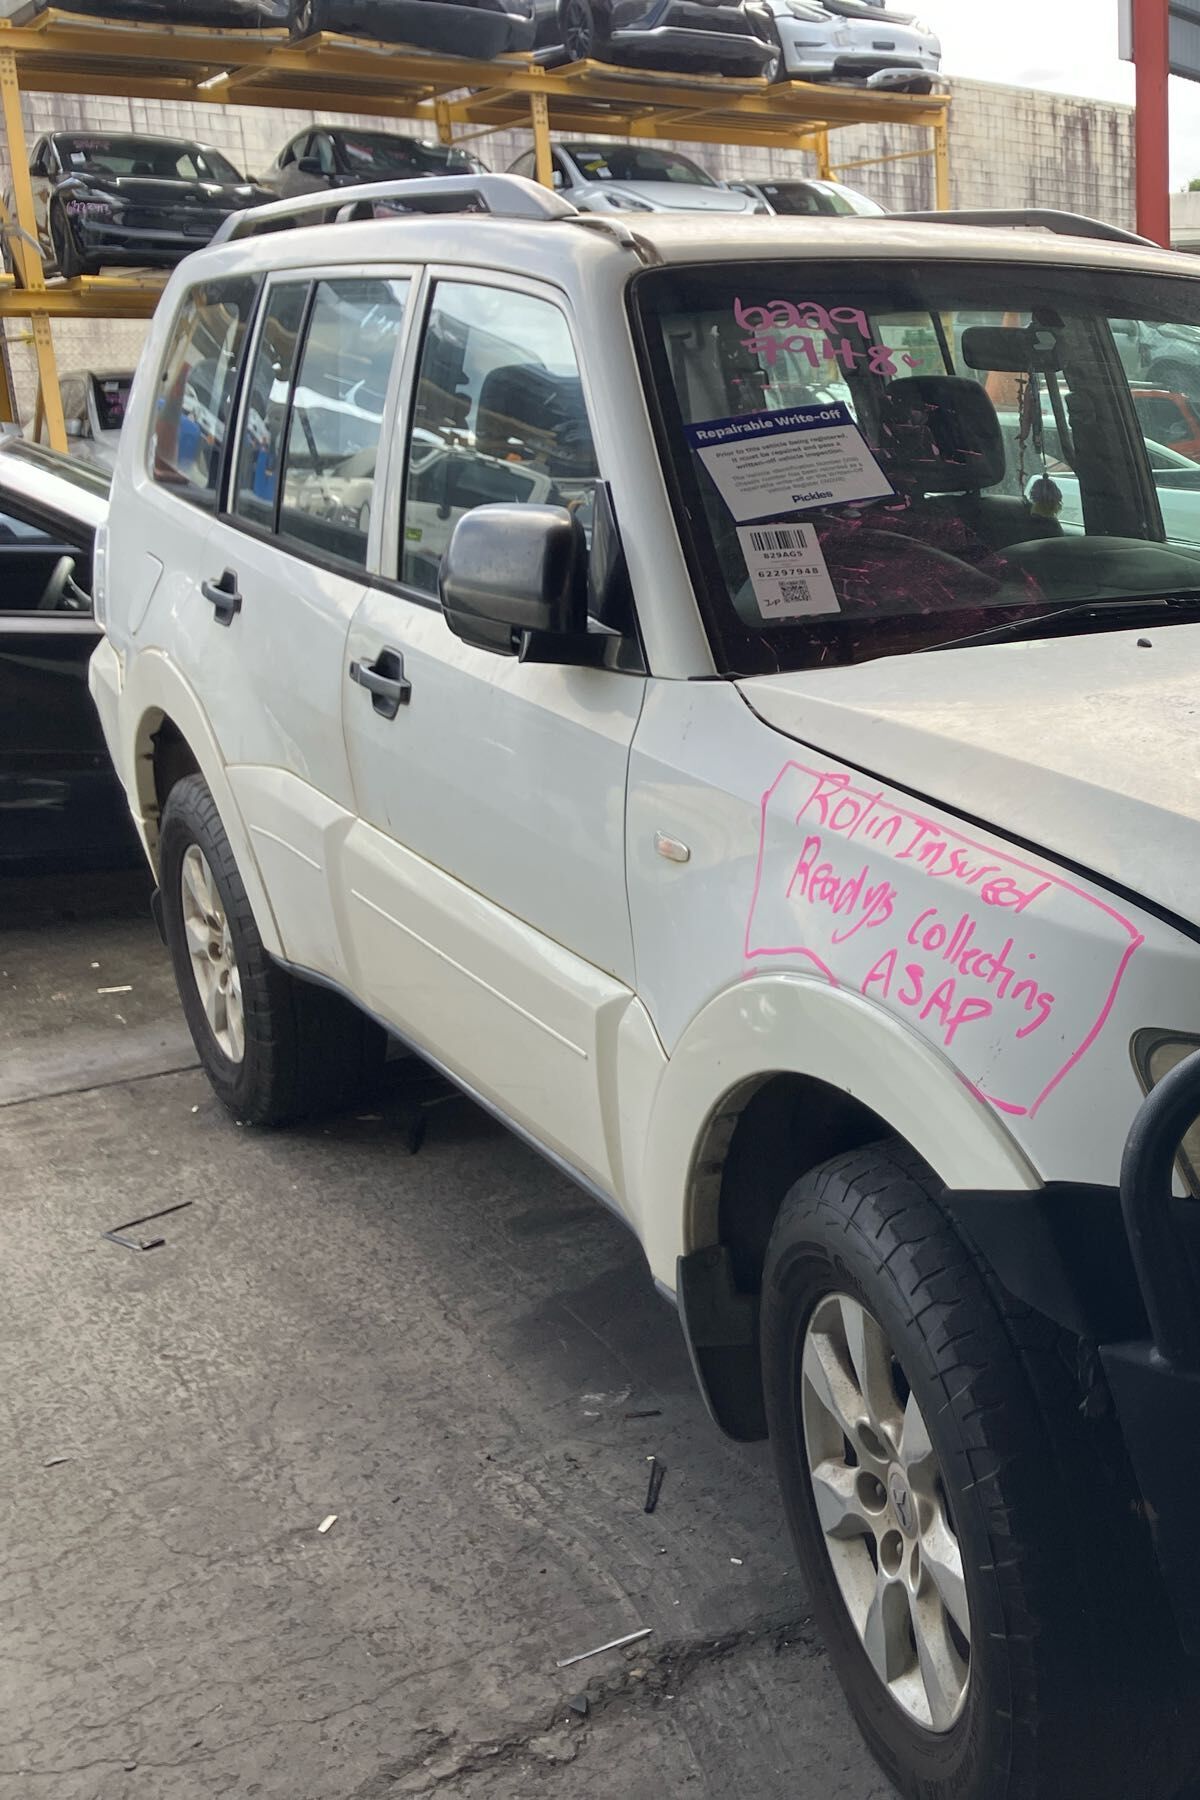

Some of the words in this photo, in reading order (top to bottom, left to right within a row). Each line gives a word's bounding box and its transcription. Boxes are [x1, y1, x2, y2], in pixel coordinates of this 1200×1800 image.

[696, 419, 773, 440] Repairable
[774, 409, 842, 428] Write-Off
[791, 489, 834, 503] Pickles
[861, 948, 993, 1046] ASAP
